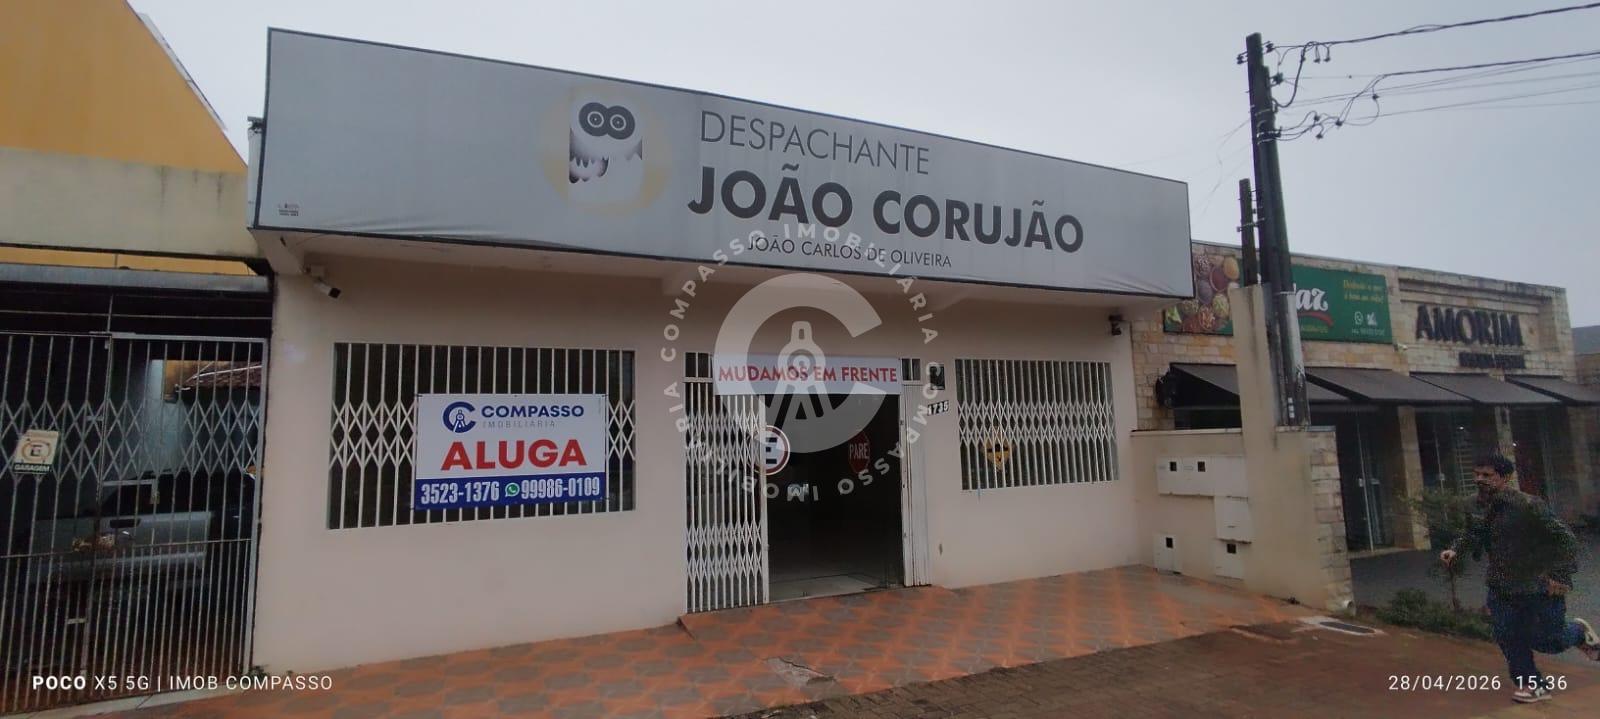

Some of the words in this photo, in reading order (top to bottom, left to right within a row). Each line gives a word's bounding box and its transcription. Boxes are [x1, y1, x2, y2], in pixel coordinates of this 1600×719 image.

[701, 110, 930, 175] DESPACHANTE
[687, 163, 853, 228] JOÃO
[873, 190, 1084, 253] CORUJÃO
[748, 235, 796, 254] JOÃO
[801, 241, 862, 260] CARLOS
[867, 247, 886, 262] DE
[890, 250, 953, 267] OLIVEIRA
[1416, 303, 1524, 346] AMORIM
[718, 365, 809, 383] MUDAMOS
[813, 366, 837, 382] EM
[841, 366, 898, 382] FRENTE
[481, 405, 585, 418] COMPASSO
[440, 439, 588, 472] ALUGA
[848, 442, 870, 460] PARE
[421, 481, 500, 505] 3523-1376
[521, 476, 600, 500] 99986-0109
